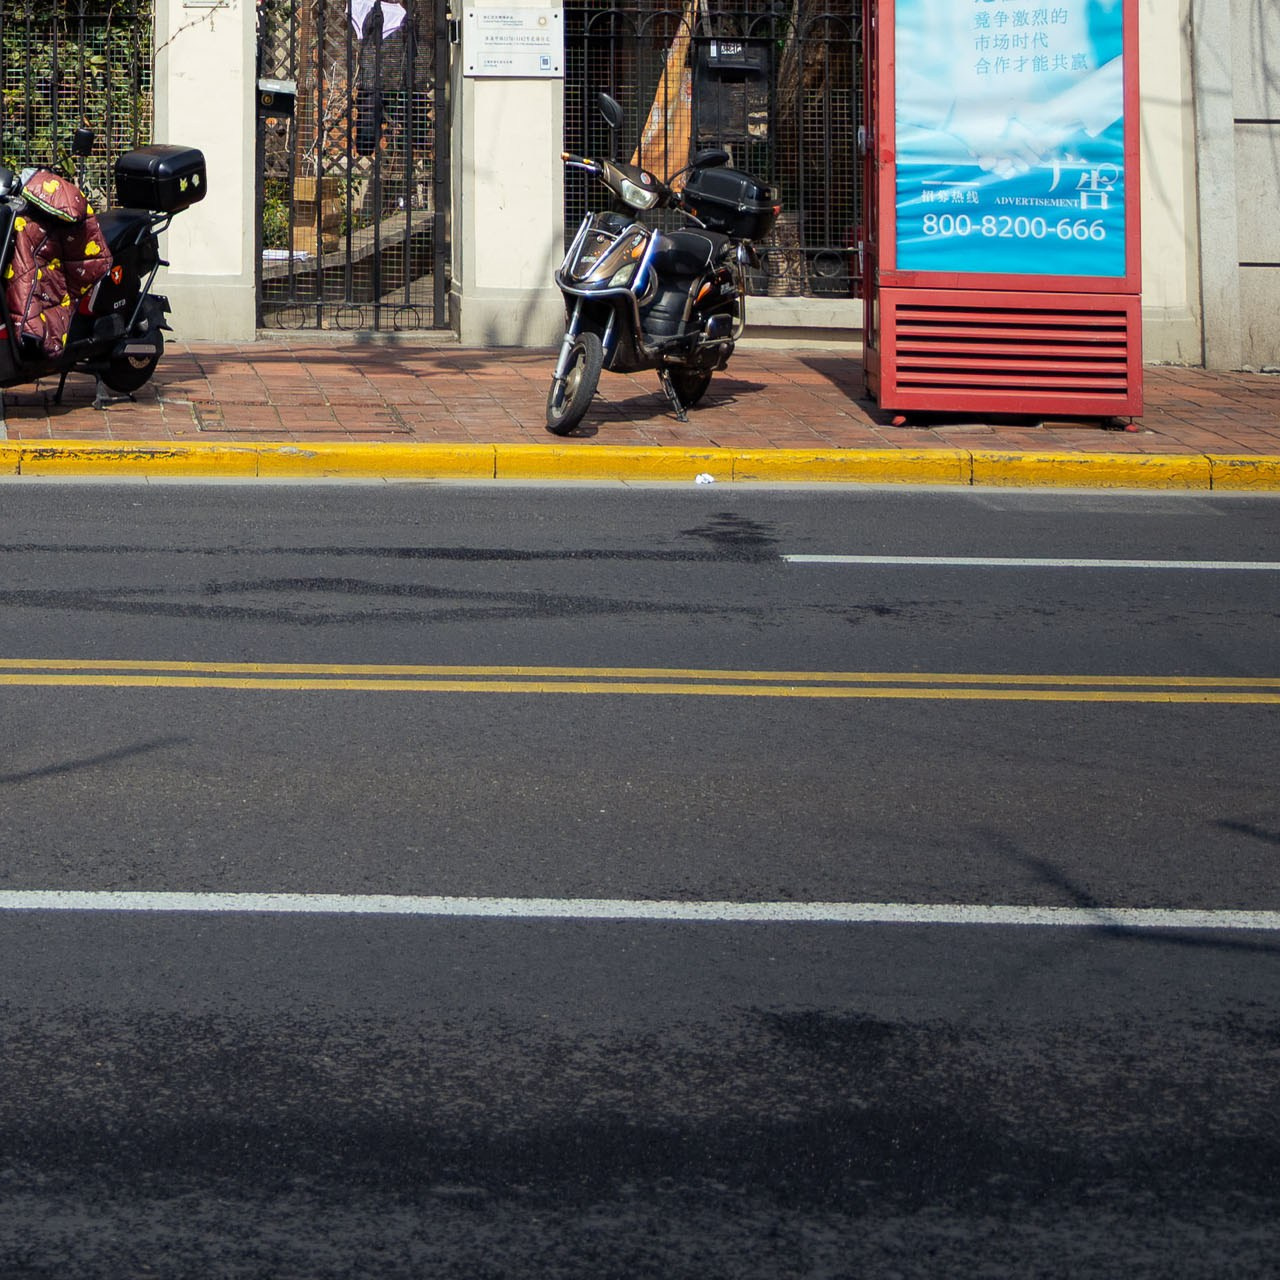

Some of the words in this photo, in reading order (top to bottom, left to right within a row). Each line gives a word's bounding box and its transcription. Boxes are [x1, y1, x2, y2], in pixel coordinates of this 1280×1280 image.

[974, 7, 1069, 29] 竞争激烈的
[974, 31, 1049, 52] 市场时代
[974, 52, 1088, 75] 合作才能共赢
[1049, 152, 1115, 210] 广告
[994, 196, 1080, 208] ADVERTISEMENT
[922, 213, 1106, 241] 800-8200-666
